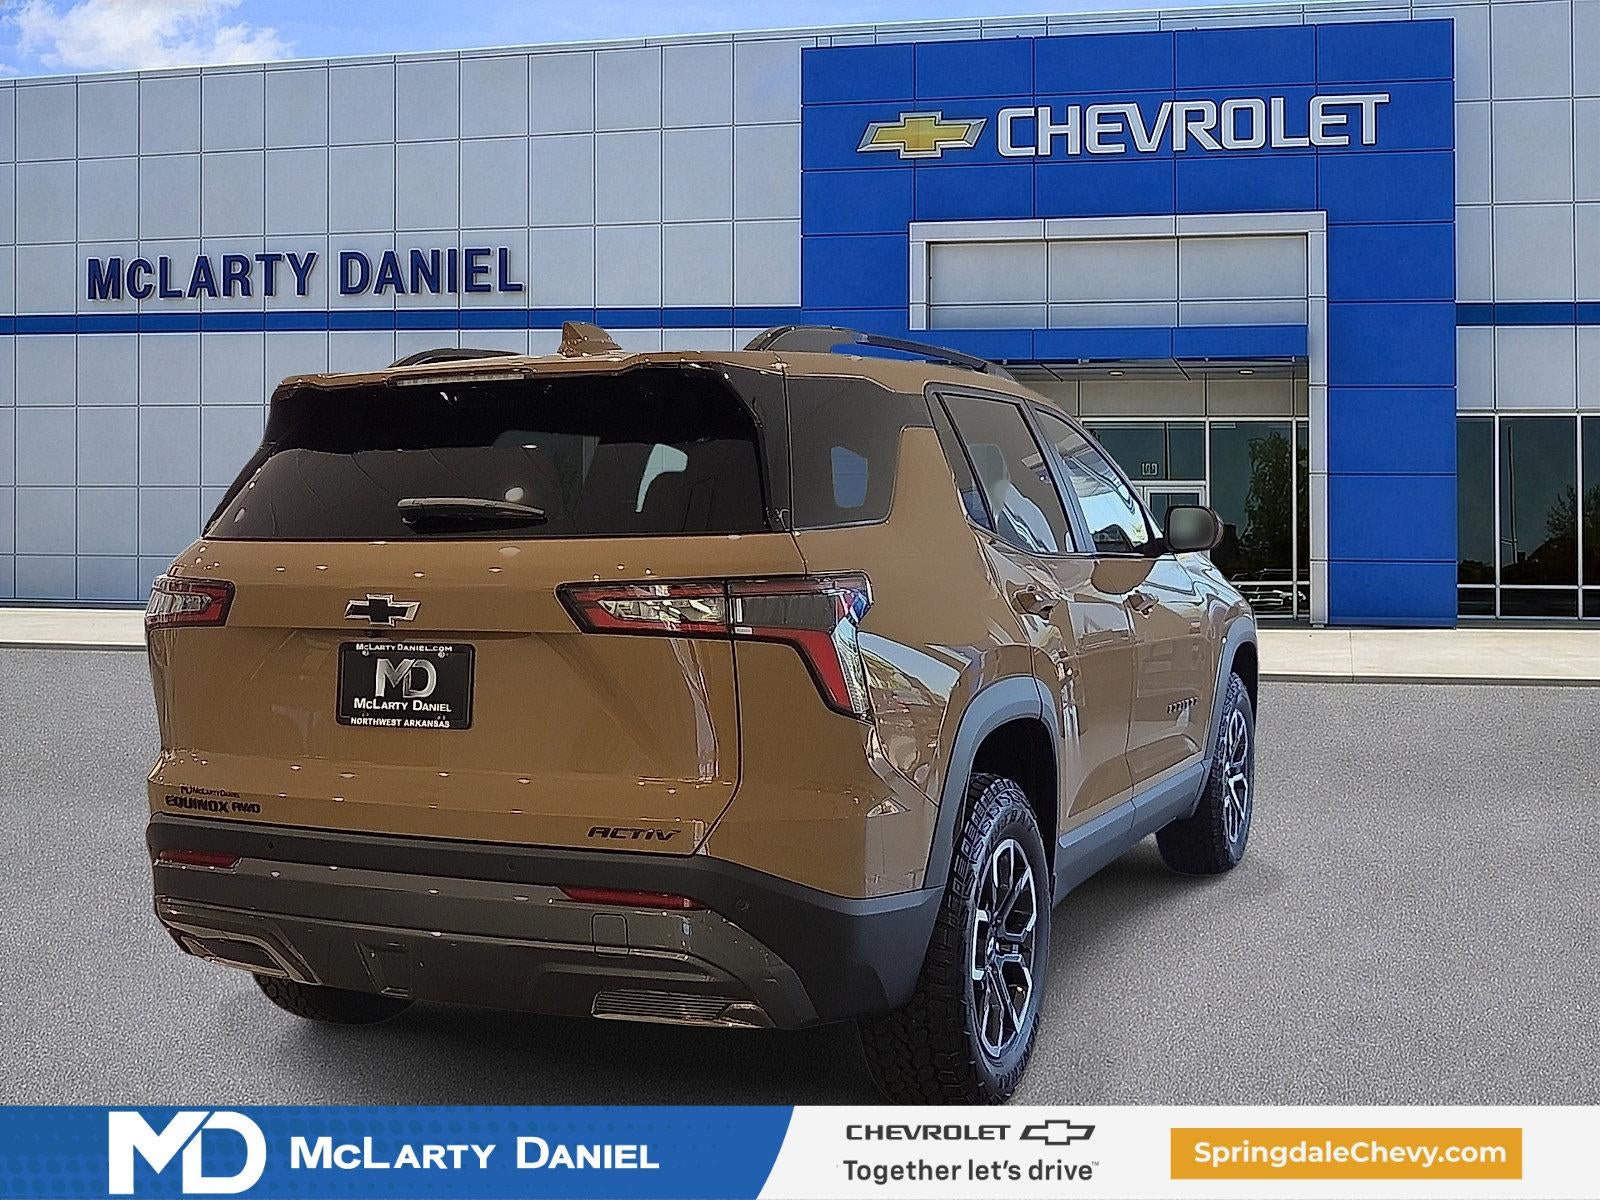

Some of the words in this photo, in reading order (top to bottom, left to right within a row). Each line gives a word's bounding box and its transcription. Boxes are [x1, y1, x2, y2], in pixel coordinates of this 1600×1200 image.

[997, 93, 1390, 158] CHEVROLET
[338, 245, 525, 295] DANIEL
[375, 658, 437, 698] MD
[412, 699, 452, 713] DANIEL
[350, 716, 402, 727] NORTHWEST
[403, 718, 450, 729] ARKANSAS
[164, 794, 229, 813] EQUINOX
[231, 801, 262, 814] AWD
[586, 826, 682, 841] ACTIV
